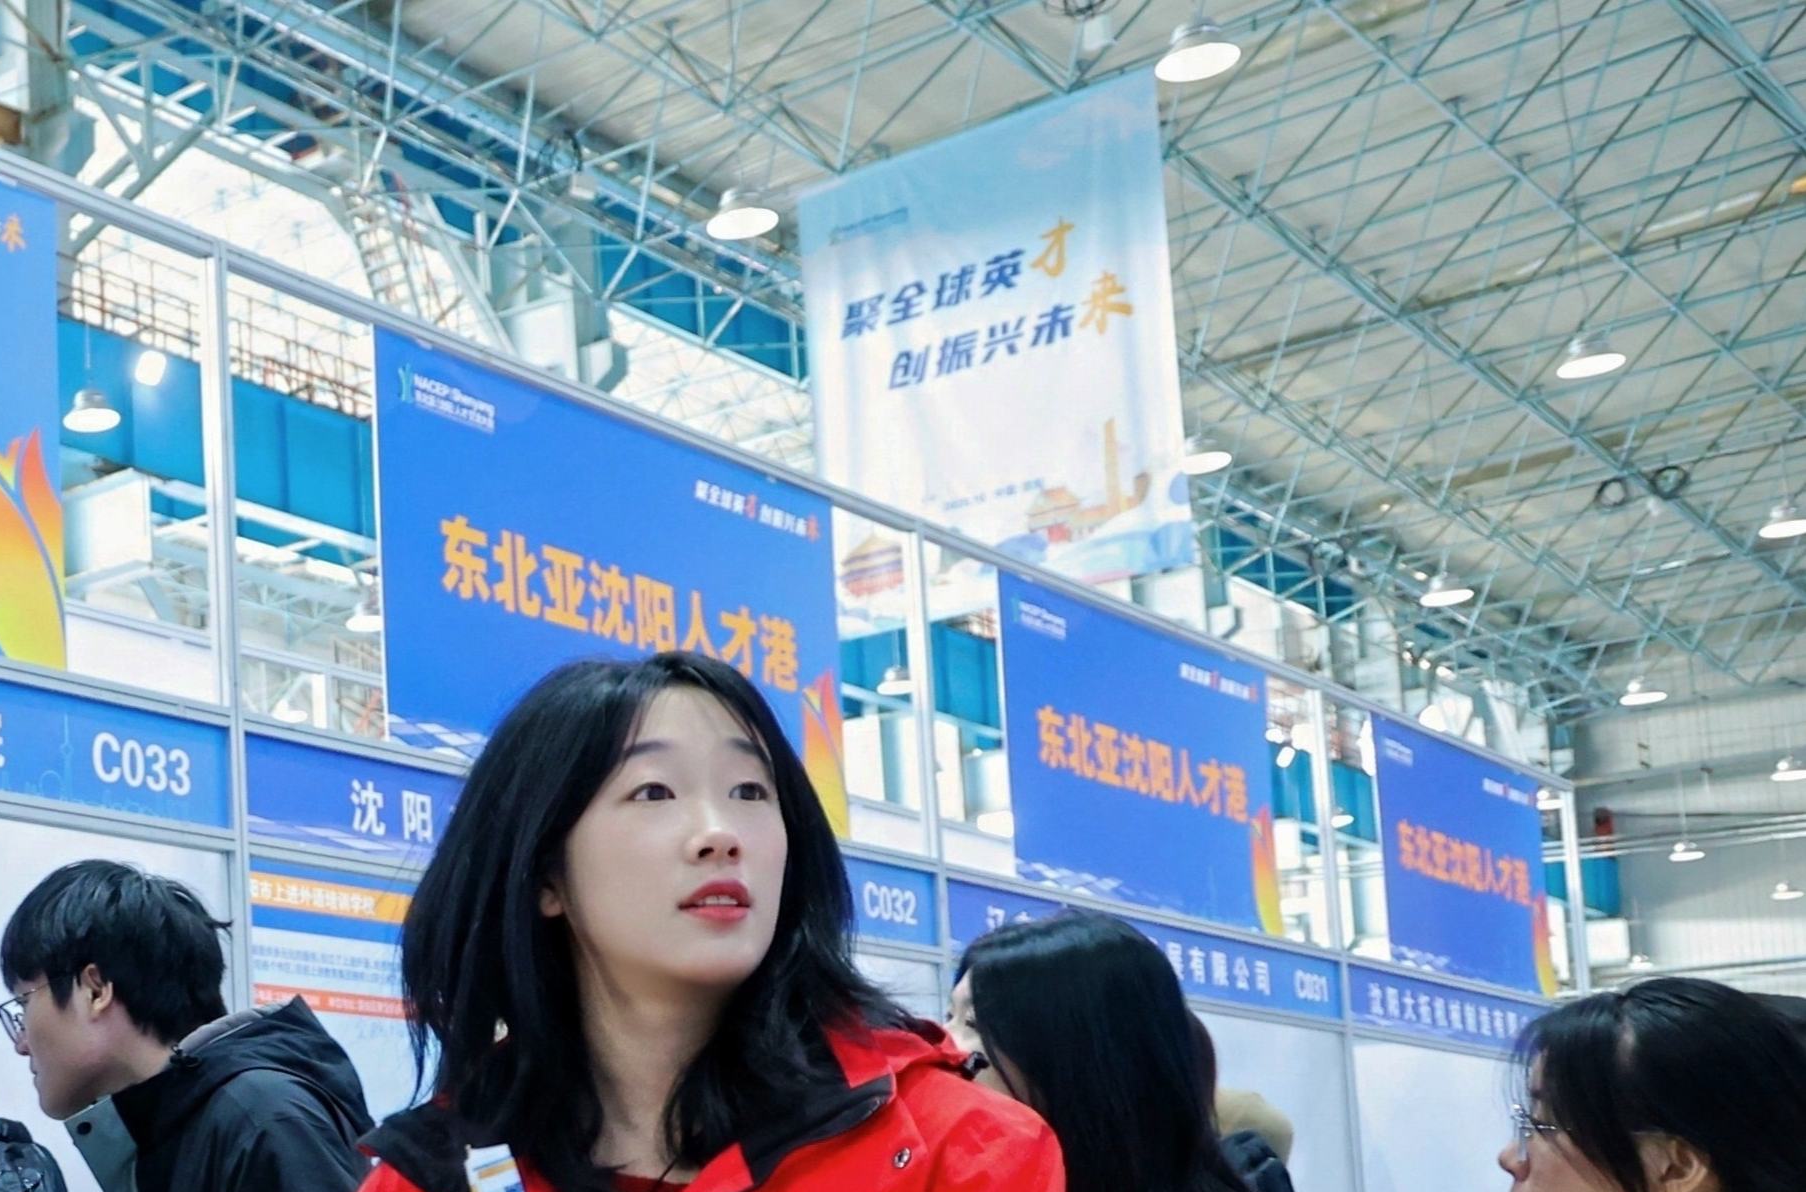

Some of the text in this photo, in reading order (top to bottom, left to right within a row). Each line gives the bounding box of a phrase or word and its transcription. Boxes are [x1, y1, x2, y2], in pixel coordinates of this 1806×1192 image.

[840, 216, 1074, 341] 聚全球英才
[888, 272, 1134, 390] 创振兴未来
[440, 515, 799, 692] 东北亚沈阳人才港
[93, 732, 190, 796] C033
[1036, 705, 1249, 823] 东北亚沈阳人才港
[350, 779, 434, 844] 沈阳
[863, 881, 918, 926] C032
[1294, 968, 1329, 1002] C031
